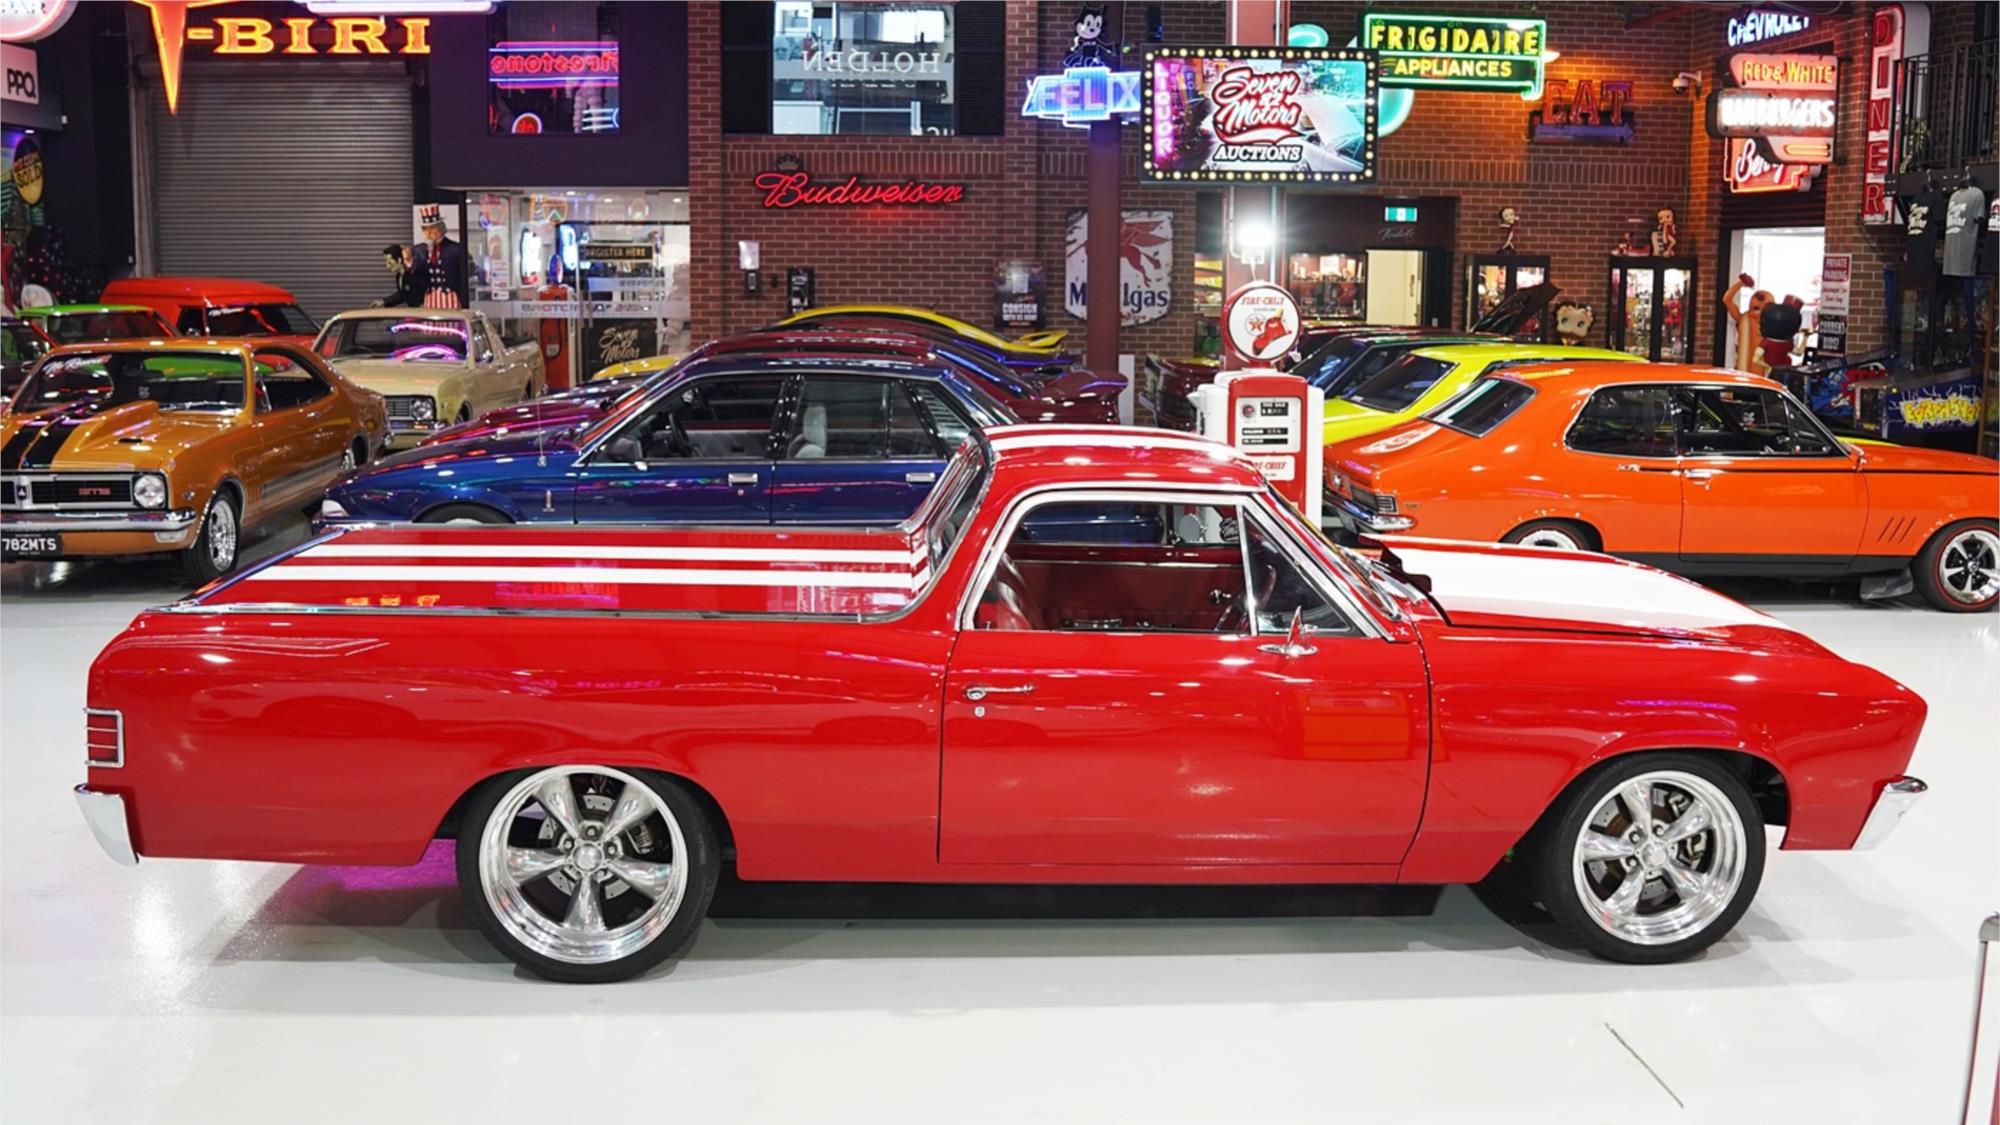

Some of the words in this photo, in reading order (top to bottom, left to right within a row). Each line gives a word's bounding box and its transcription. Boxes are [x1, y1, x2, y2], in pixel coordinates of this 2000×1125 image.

[1371, 24, 1540, 54] FRIGIDAIRE
[7, 67, 37, 98] PPQ
[1394, 58, 1513, 77] APPLIANCES
[1039, 78, 1140, 111] FELIX
[1214, 68, 1298, 104] Seven
[1540, 80, 1633, 124] EAT
[1154, 63, 1173, 156] LIQUOR
[1215, 101, 1299, 133] Motors
[1721, 97, 1836, 127] HAMBURGERS
[1866, 14, 1894, 213] DINER
[1214, 146, 1302, 161] AUCTIONS
[754, 172, 962, 208] Budweiser
[1070, 281, 1169, 313] Mlgas
[2, 537, 57, 551] 782MTS
